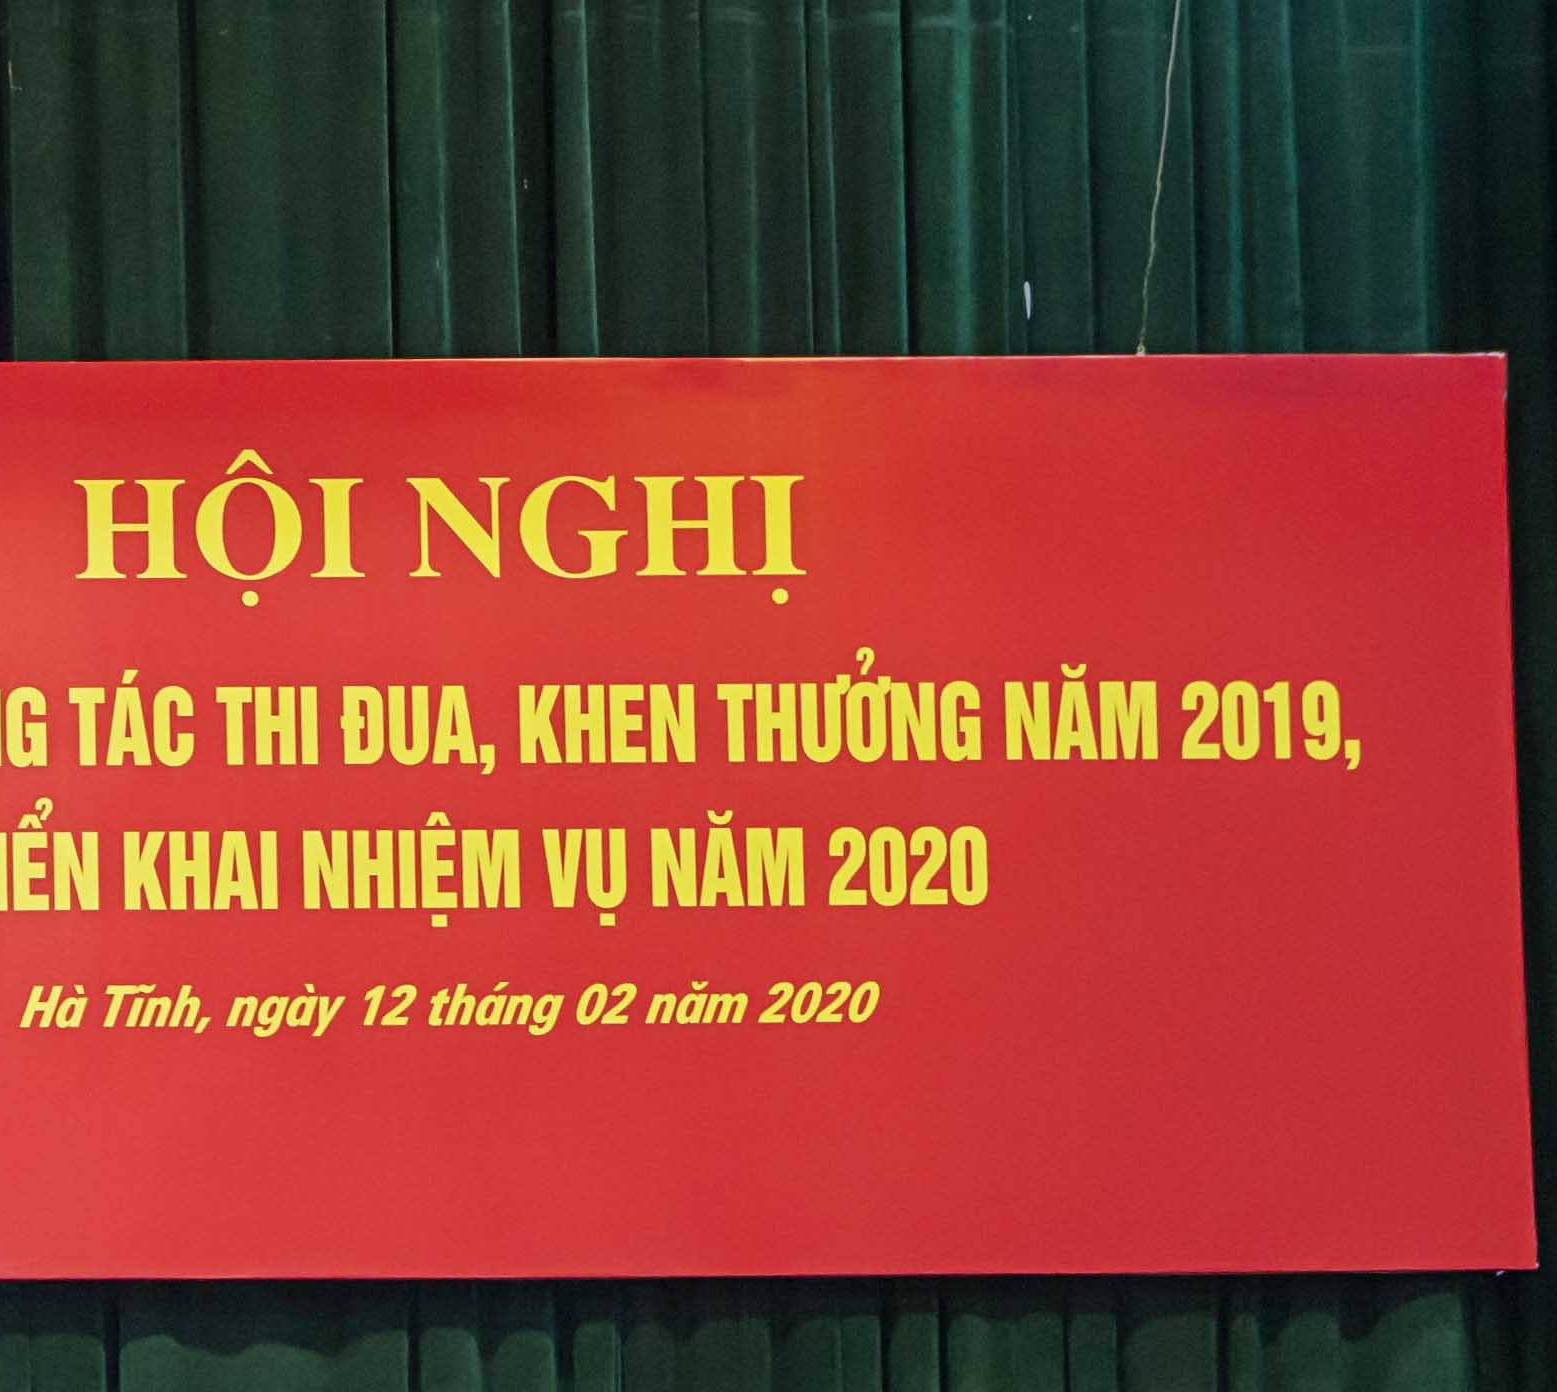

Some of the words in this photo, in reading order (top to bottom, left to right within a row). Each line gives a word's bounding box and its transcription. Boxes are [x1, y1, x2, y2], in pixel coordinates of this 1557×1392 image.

[73, 447, 366, 607] HỘI
[406, 475, 807, 605] NGHỊ
[68, 669, 195, 767] TÁC
[215, 685, 319, 766] THI
[340, 685, 496, 775] ĐUA,
[518, 683, 696, 764] KHEN
[716, 646, 982, 763] THƯỞNG
[1004, 663, 1159, 761] NĂM
[1181, 680, 1361, 770] 2019,
[123, 830, 279, 911] KHAI
[302, 811, 521, 928] NHIỆM
[541, 828, 627, 927] VỤ
[650, 809, 806, 908] NĂM
[828, 825, 989, 907] 2020
[19, 984, 88, 1029] Hà
[103, 983, 211, 1034] Tĩnh,
[225, 983, 346, 1038] ngày
[363, 984, 418, 1027] 12
[428, 981, 565, 1036] tháng
[576, 982, 638, 1026] 02
[644, 981, 749, 1025] năm
[757, 980, 880, 1024] 2020
